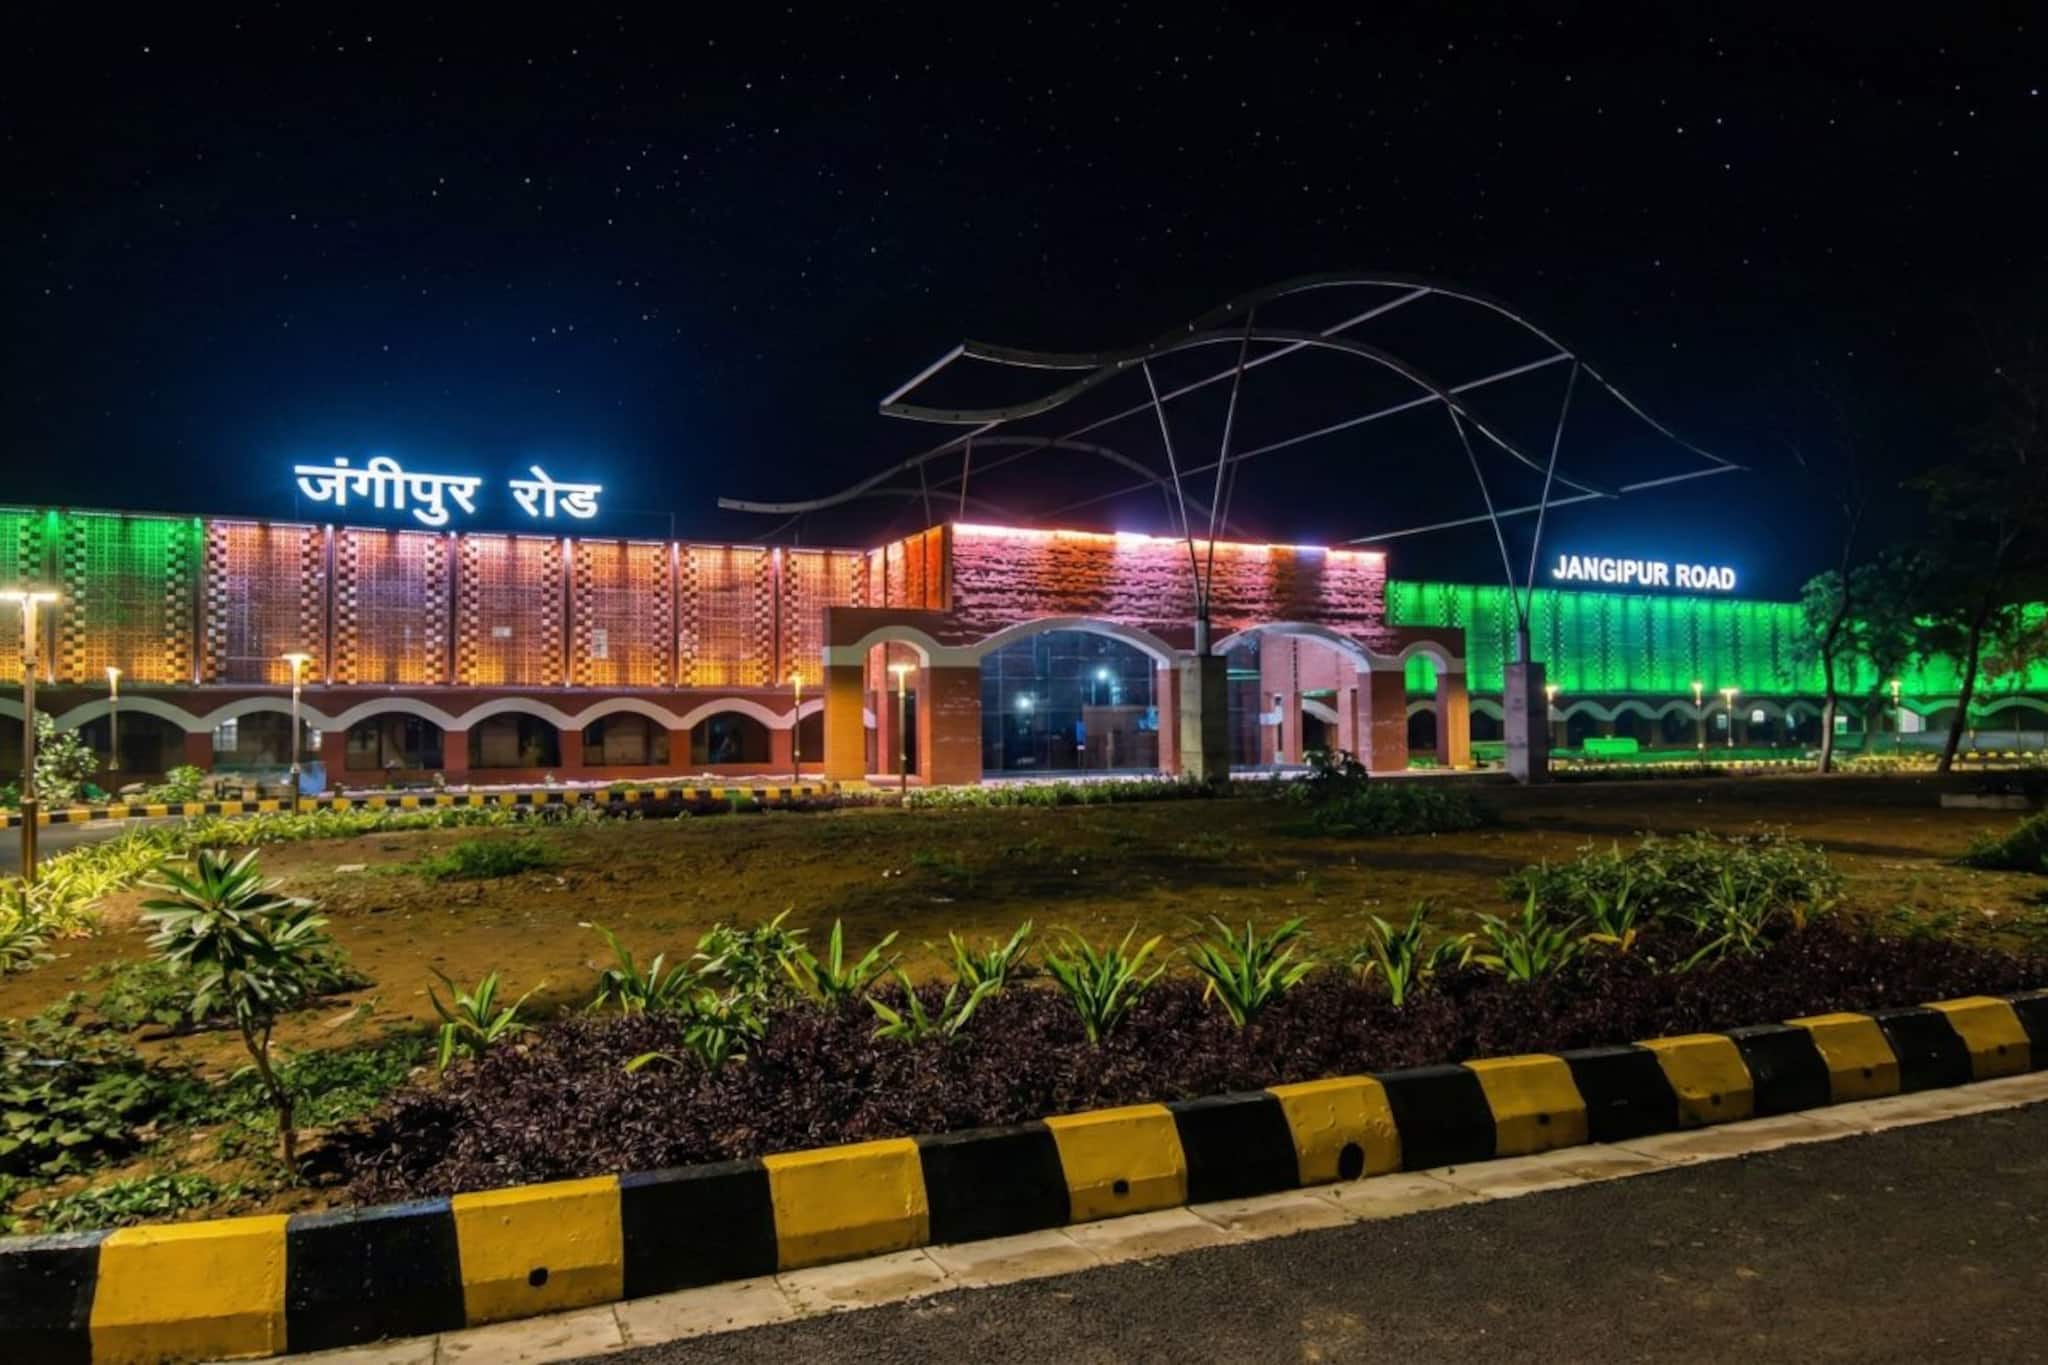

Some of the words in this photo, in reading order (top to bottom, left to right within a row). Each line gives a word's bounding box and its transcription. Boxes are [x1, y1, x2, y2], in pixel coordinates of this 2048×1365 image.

[294, 456, 482, 526] जंगीपुर
[508, 465, 603, 518] रोड
[1552, 555, 1669, 586] JANGIPUR
[1675, 563, 1736, 590] ROAD
